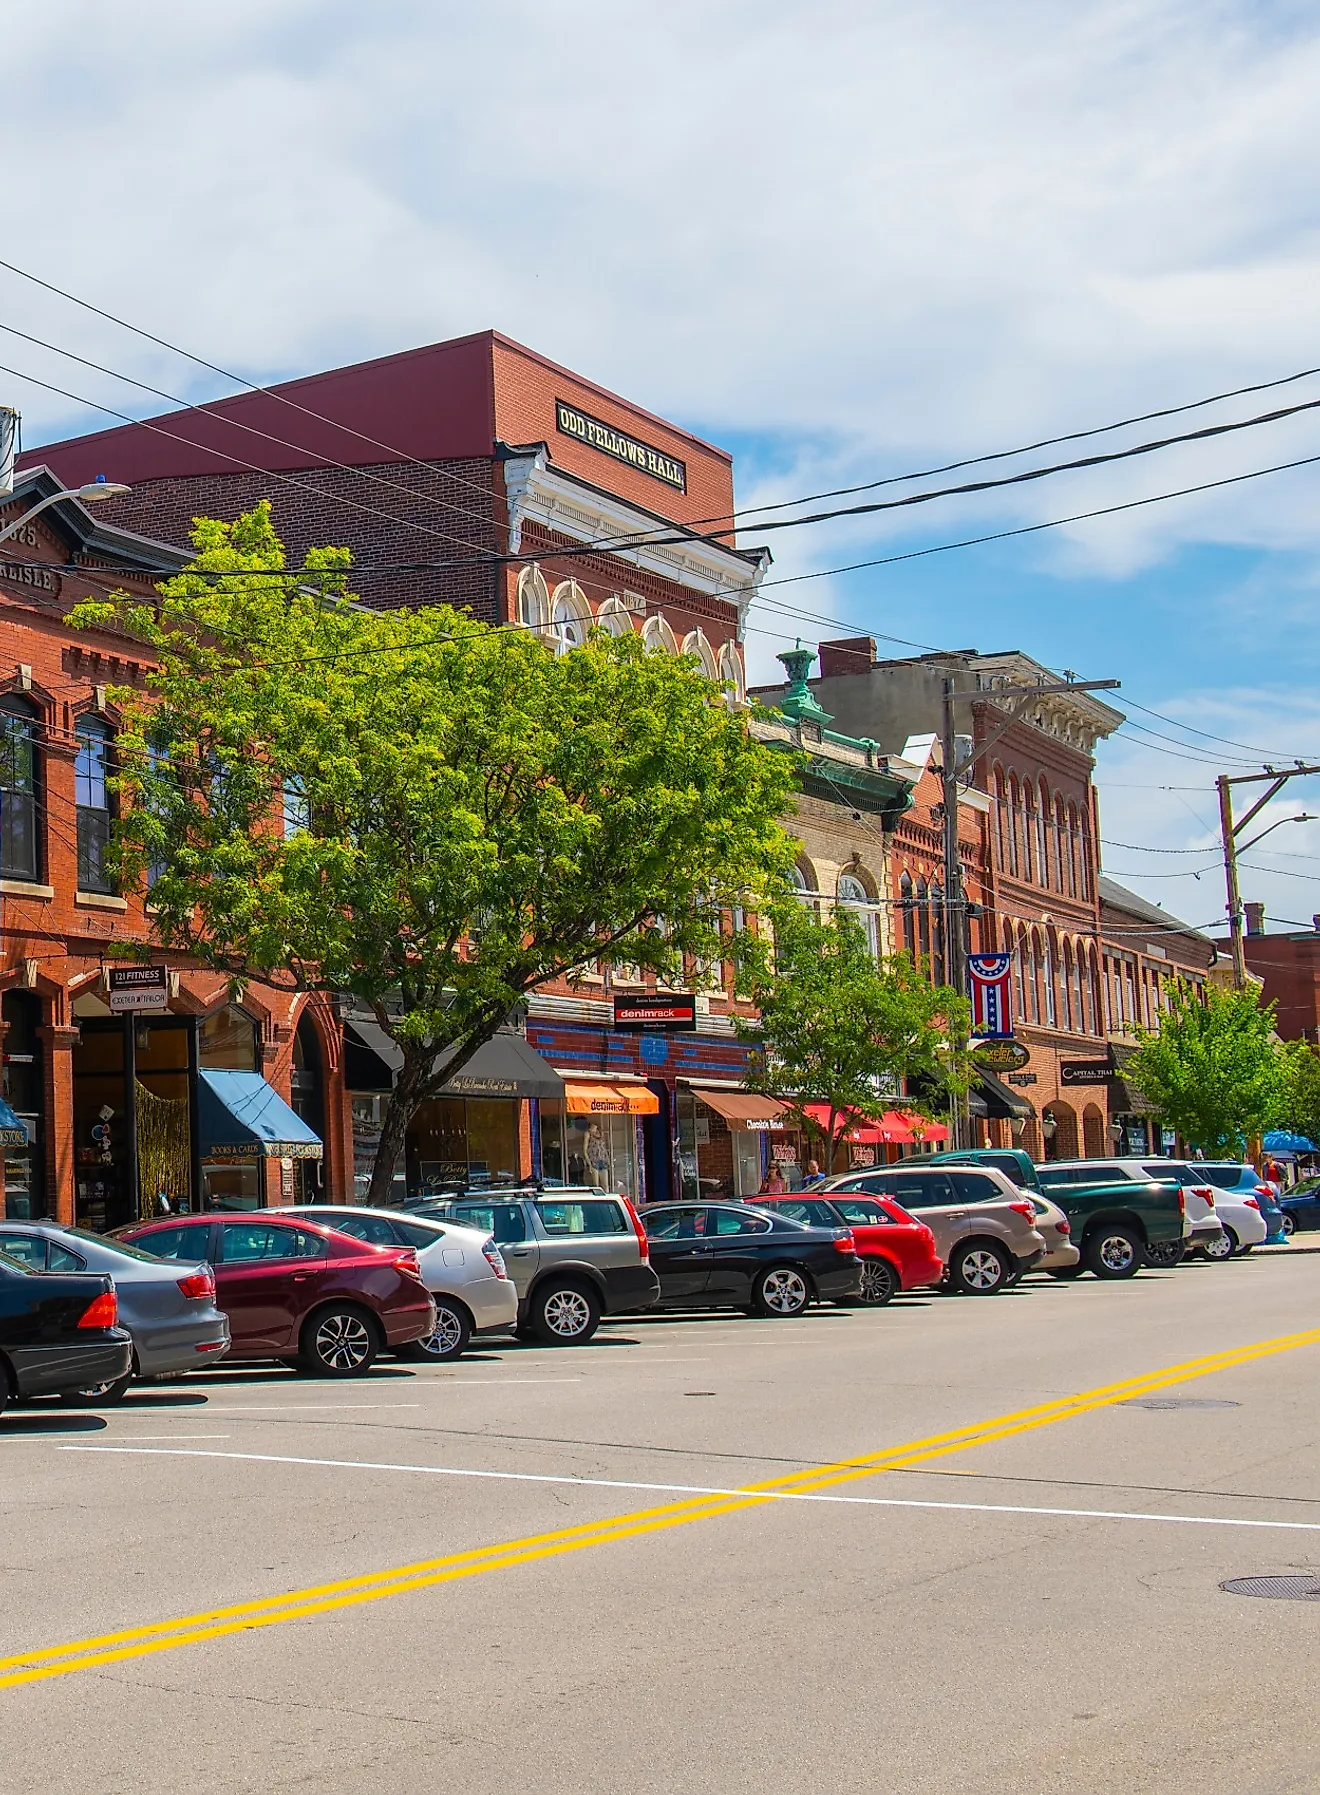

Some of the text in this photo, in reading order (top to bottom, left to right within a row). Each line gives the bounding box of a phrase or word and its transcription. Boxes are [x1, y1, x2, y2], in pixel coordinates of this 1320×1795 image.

[560, 408, 681, 483] ODD FELLOWS HALL
[126, 969, 160, 980] FITNESS
[620, 1009, 675, 1018] denimrack
[210, 1146, 231, 1155] BOOKS
[238, 1145, 259, 1153] CARDS
